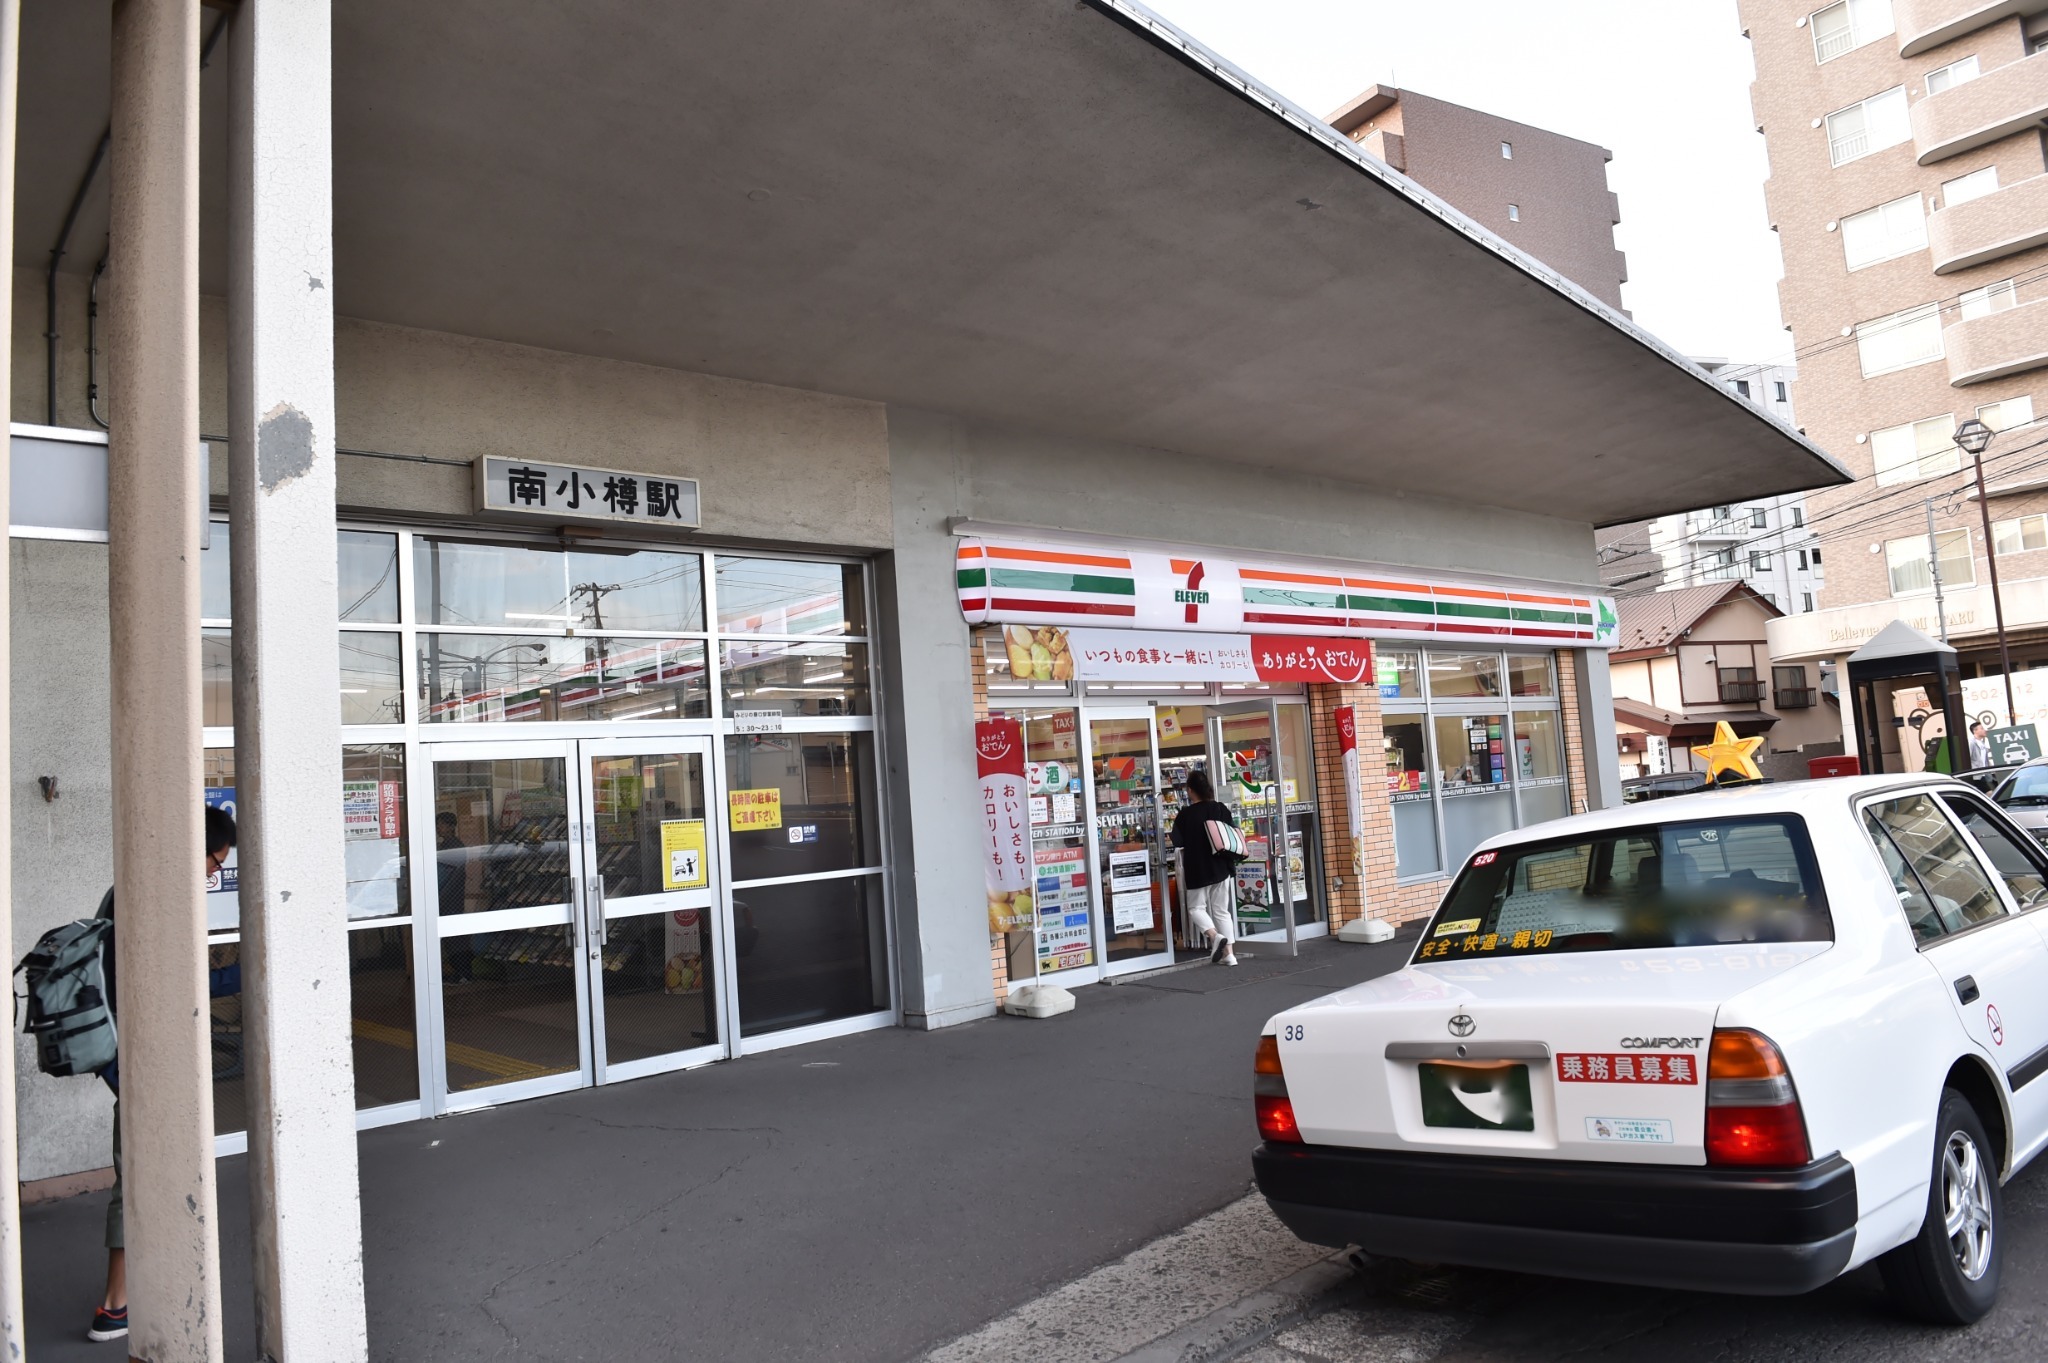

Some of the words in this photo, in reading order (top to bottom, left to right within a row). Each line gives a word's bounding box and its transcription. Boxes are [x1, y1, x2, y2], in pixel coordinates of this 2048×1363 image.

[508, 466, 682, 519] 南小樽駅
[1085, 647, 1214, 665] いつもの食事と一緒に!
[1263, 652, 1317, 670] ありがとう
[1325, 649, 1360, 668] おでん
[1994, 729, 2030, 743] TAXI
[1045, 766, 1060, 784] 酒
[383, 783, 396, 836] 防犯カメラ作動中
[983, 785, 1003, 881] カロリーも!
[1003, 784, 1027, 880] おいしさも!
[1045, 826, 1074, 838] STATION
[1075, 826, 1085, 836] by
[1063, 850, 1078, 859] ATM
[1474, 852, 1495, 866] 520
[1420, 930, 1553, 958] 安全・快適・親切
[1285, 1024, 1304, 1041] 38
[1621, 1037, 1704, 1049] COMFORT
[1562, 1056, 1692, 1082] 乗務員募集
